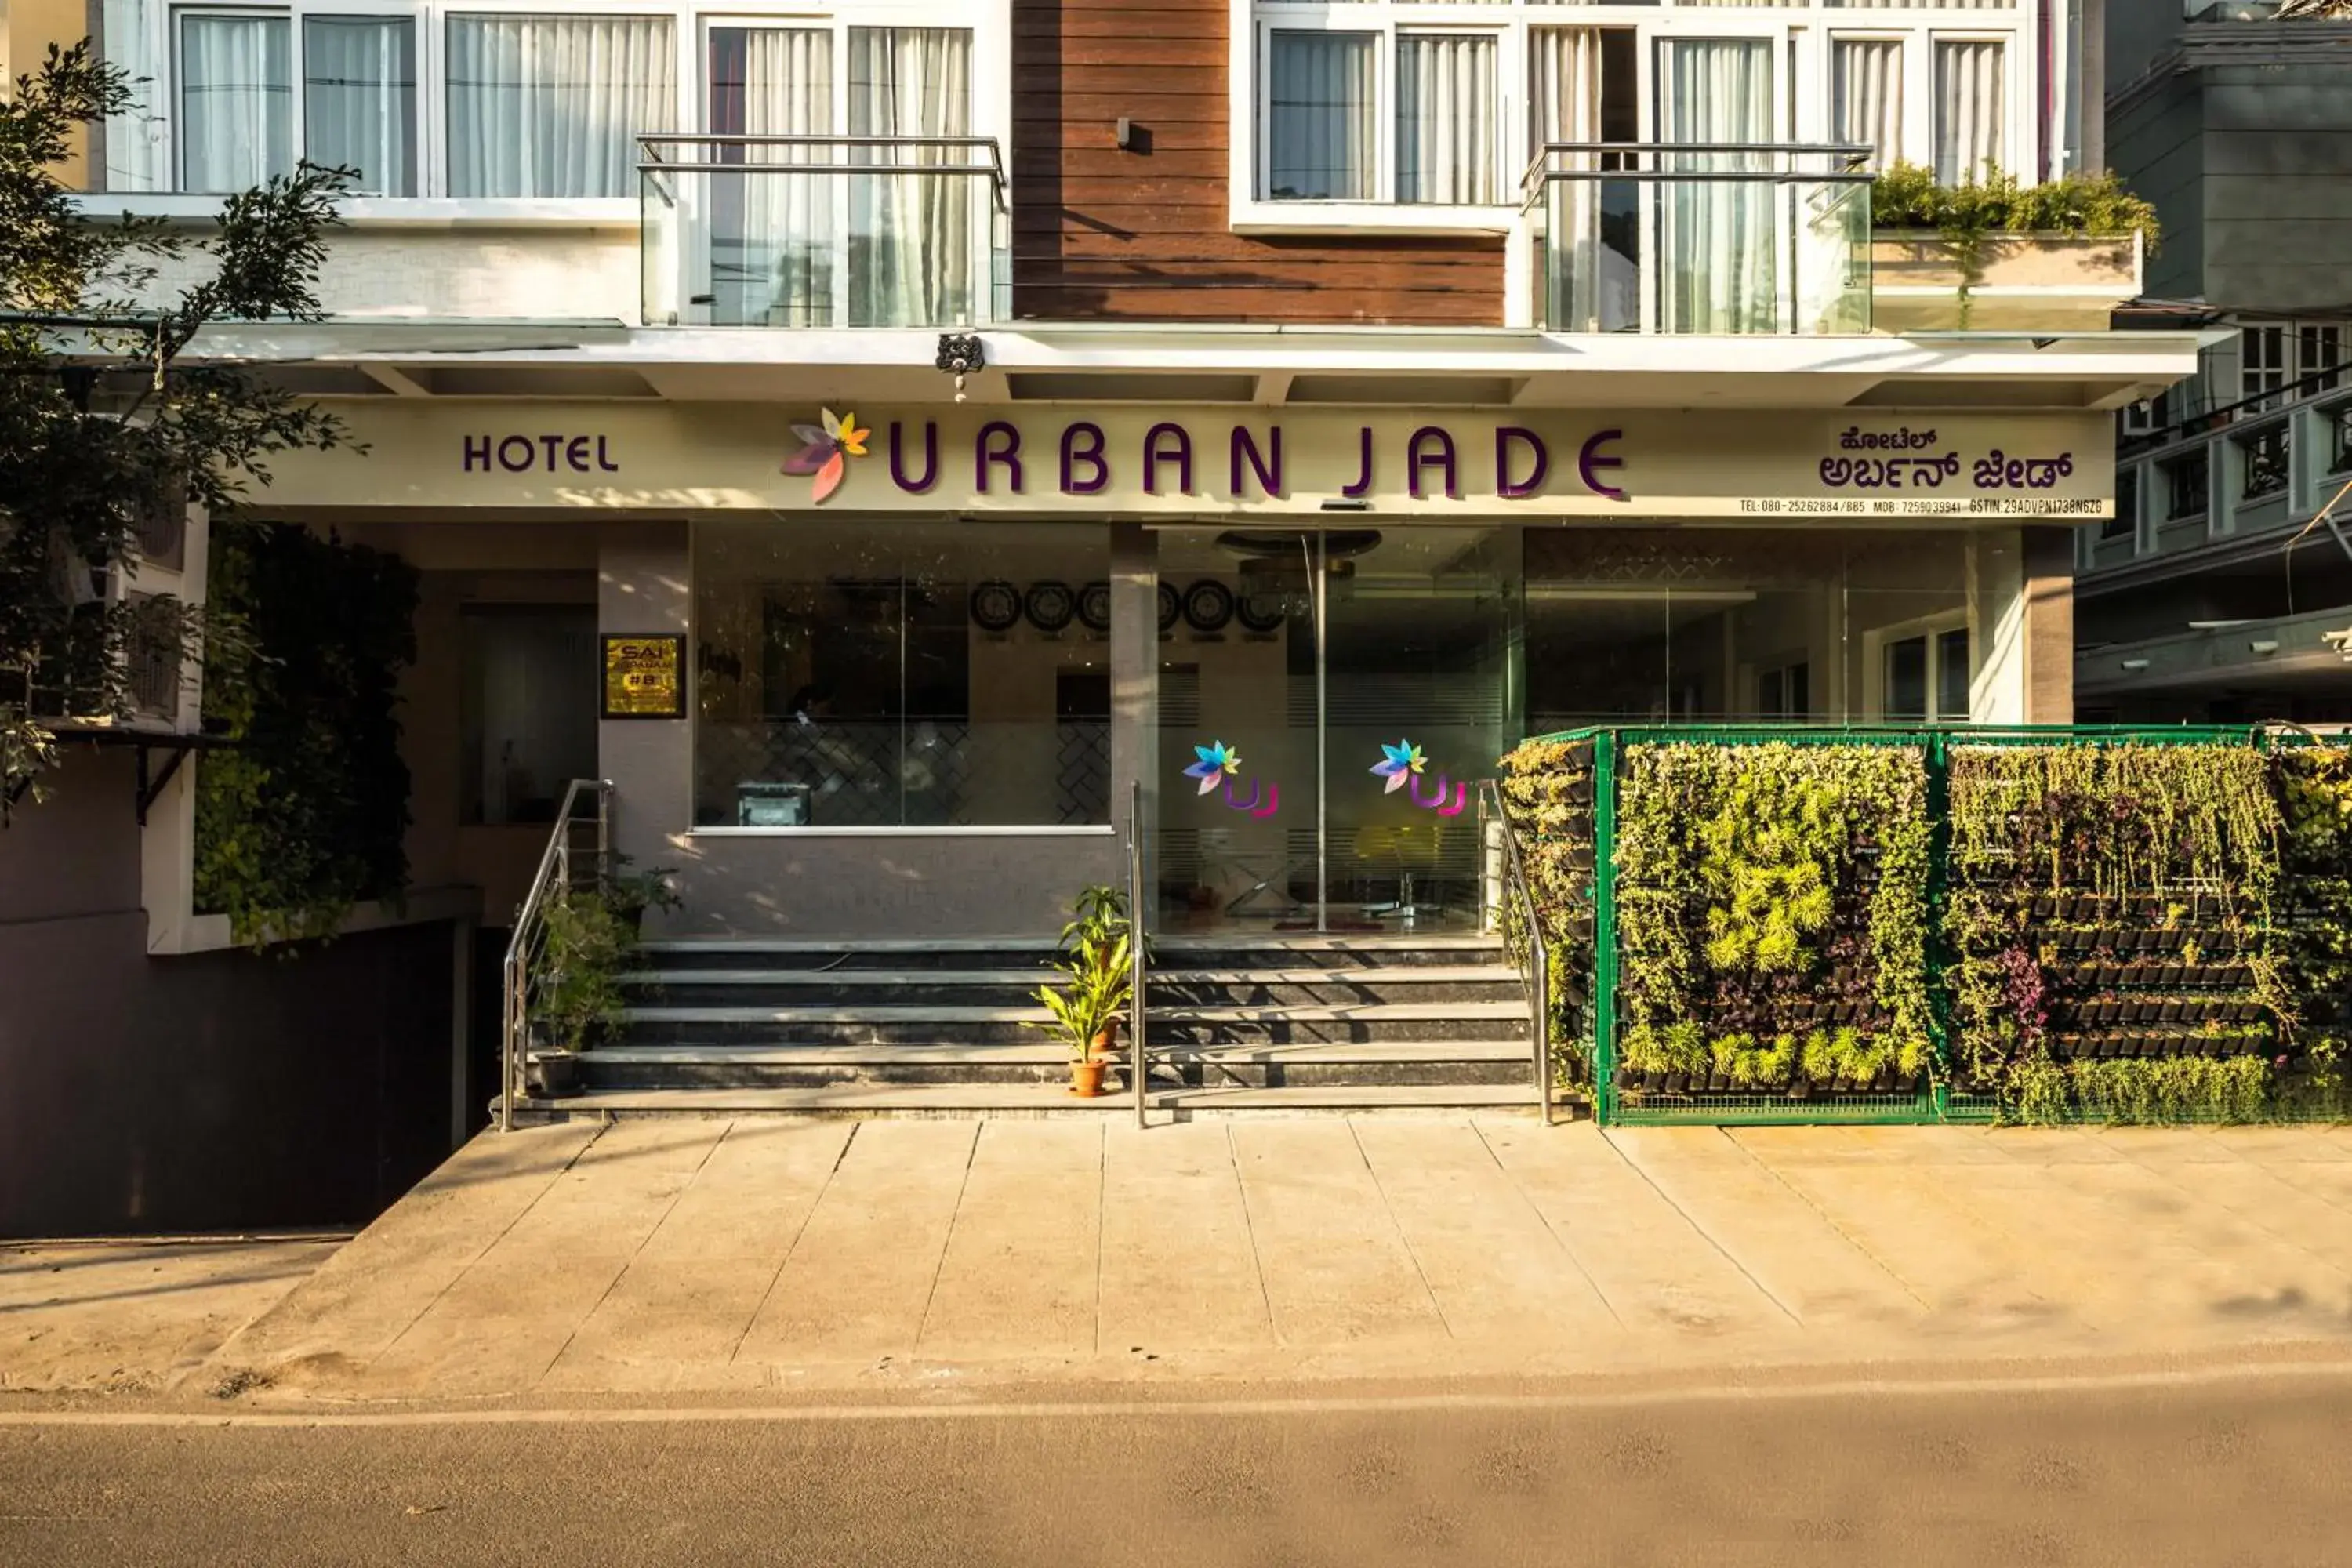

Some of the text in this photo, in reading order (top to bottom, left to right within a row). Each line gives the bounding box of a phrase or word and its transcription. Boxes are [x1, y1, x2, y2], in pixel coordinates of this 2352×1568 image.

[463, 434, 619, 473] HOTEL
[1839, 425, 1937, 451] ಹೋಟೆಲ್
[889, 420, 1624, 499] URBAN JADE
[1819, 448, 2074, 488] ಅರ್ಬನ್ ಜೇಡ್
